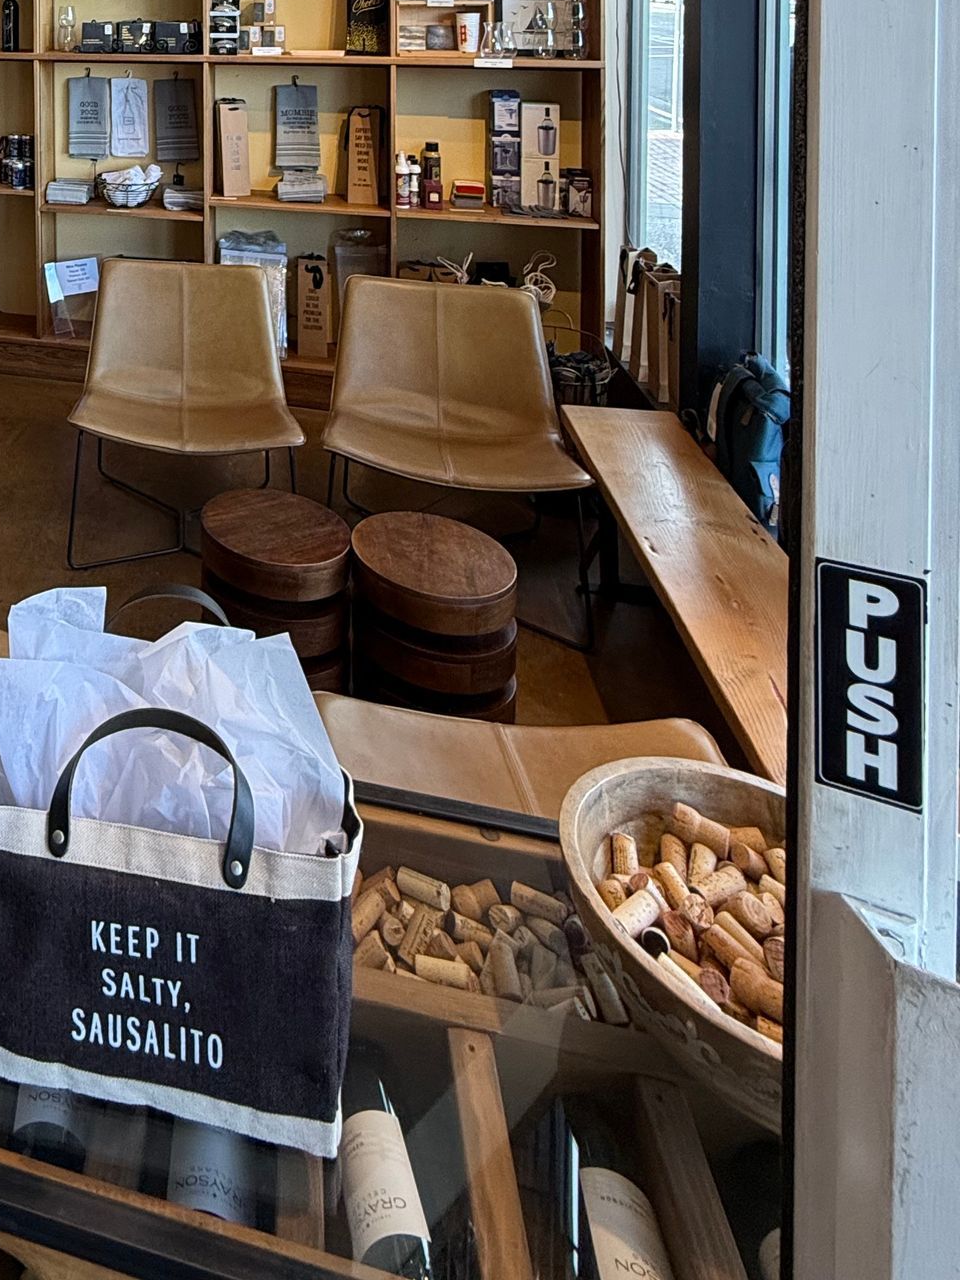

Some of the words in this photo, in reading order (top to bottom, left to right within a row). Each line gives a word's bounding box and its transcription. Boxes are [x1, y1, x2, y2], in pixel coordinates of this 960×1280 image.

[845, 578, 900, 791] PUSH
[91, 919, 159, 959] KEEP
[176, 931, 200, 963] IT
[101, 968, 191, 1013] SALTY,
[71, 1008, 223, 1069] SAUSALITO
